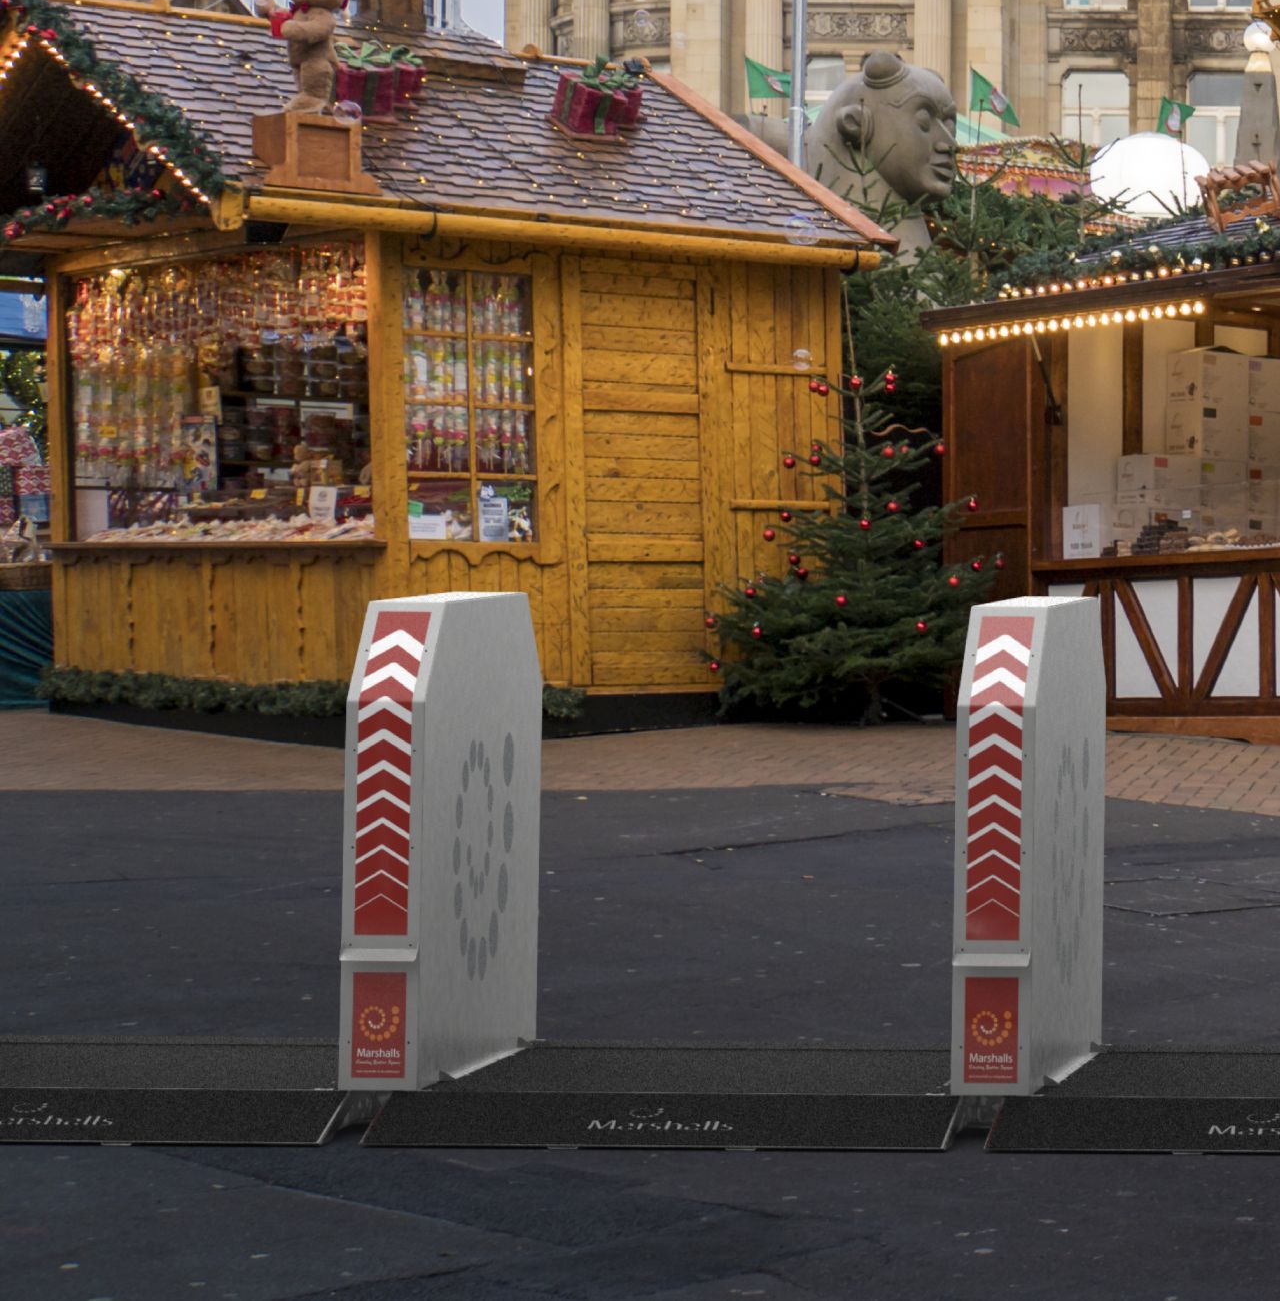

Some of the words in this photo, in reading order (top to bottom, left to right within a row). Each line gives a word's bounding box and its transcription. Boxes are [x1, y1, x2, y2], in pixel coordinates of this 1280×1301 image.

[356, 1047, 401, 1058] Marshalls
[969, 1052, 1013, 1064] Marshalls
[588, 1120, 733, 1131] Marshalls
